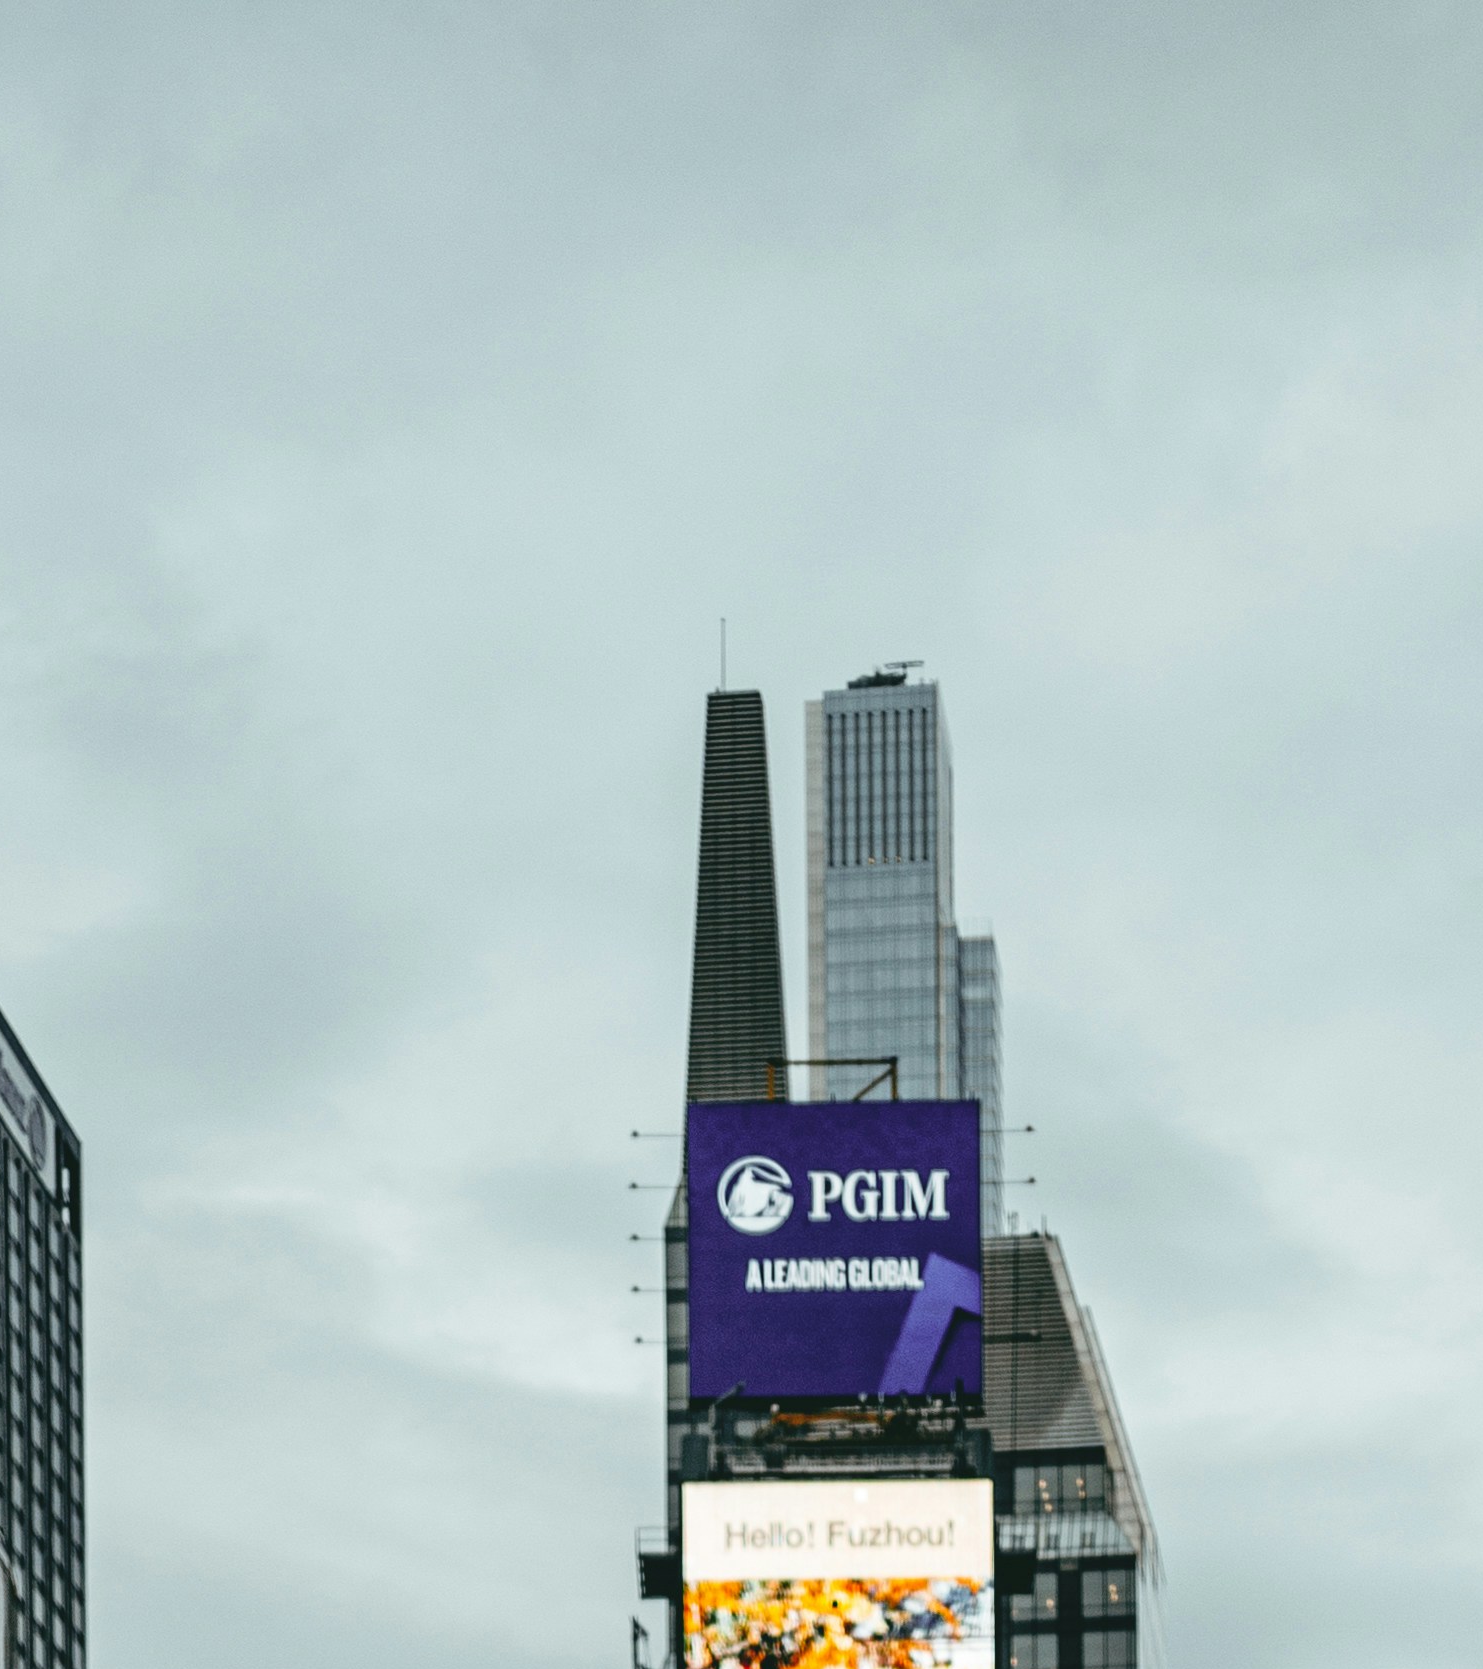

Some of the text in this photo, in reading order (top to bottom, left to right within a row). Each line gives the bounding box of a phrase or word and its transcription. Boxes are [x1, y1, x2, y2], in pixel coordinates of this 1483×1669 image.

[808, 1170, 949, 1221] PGIM
[746, 1258, 923, 1292] A LEADING GLOBAL
[724, 1519, 955, 1551] Hello! Fuzhou!
